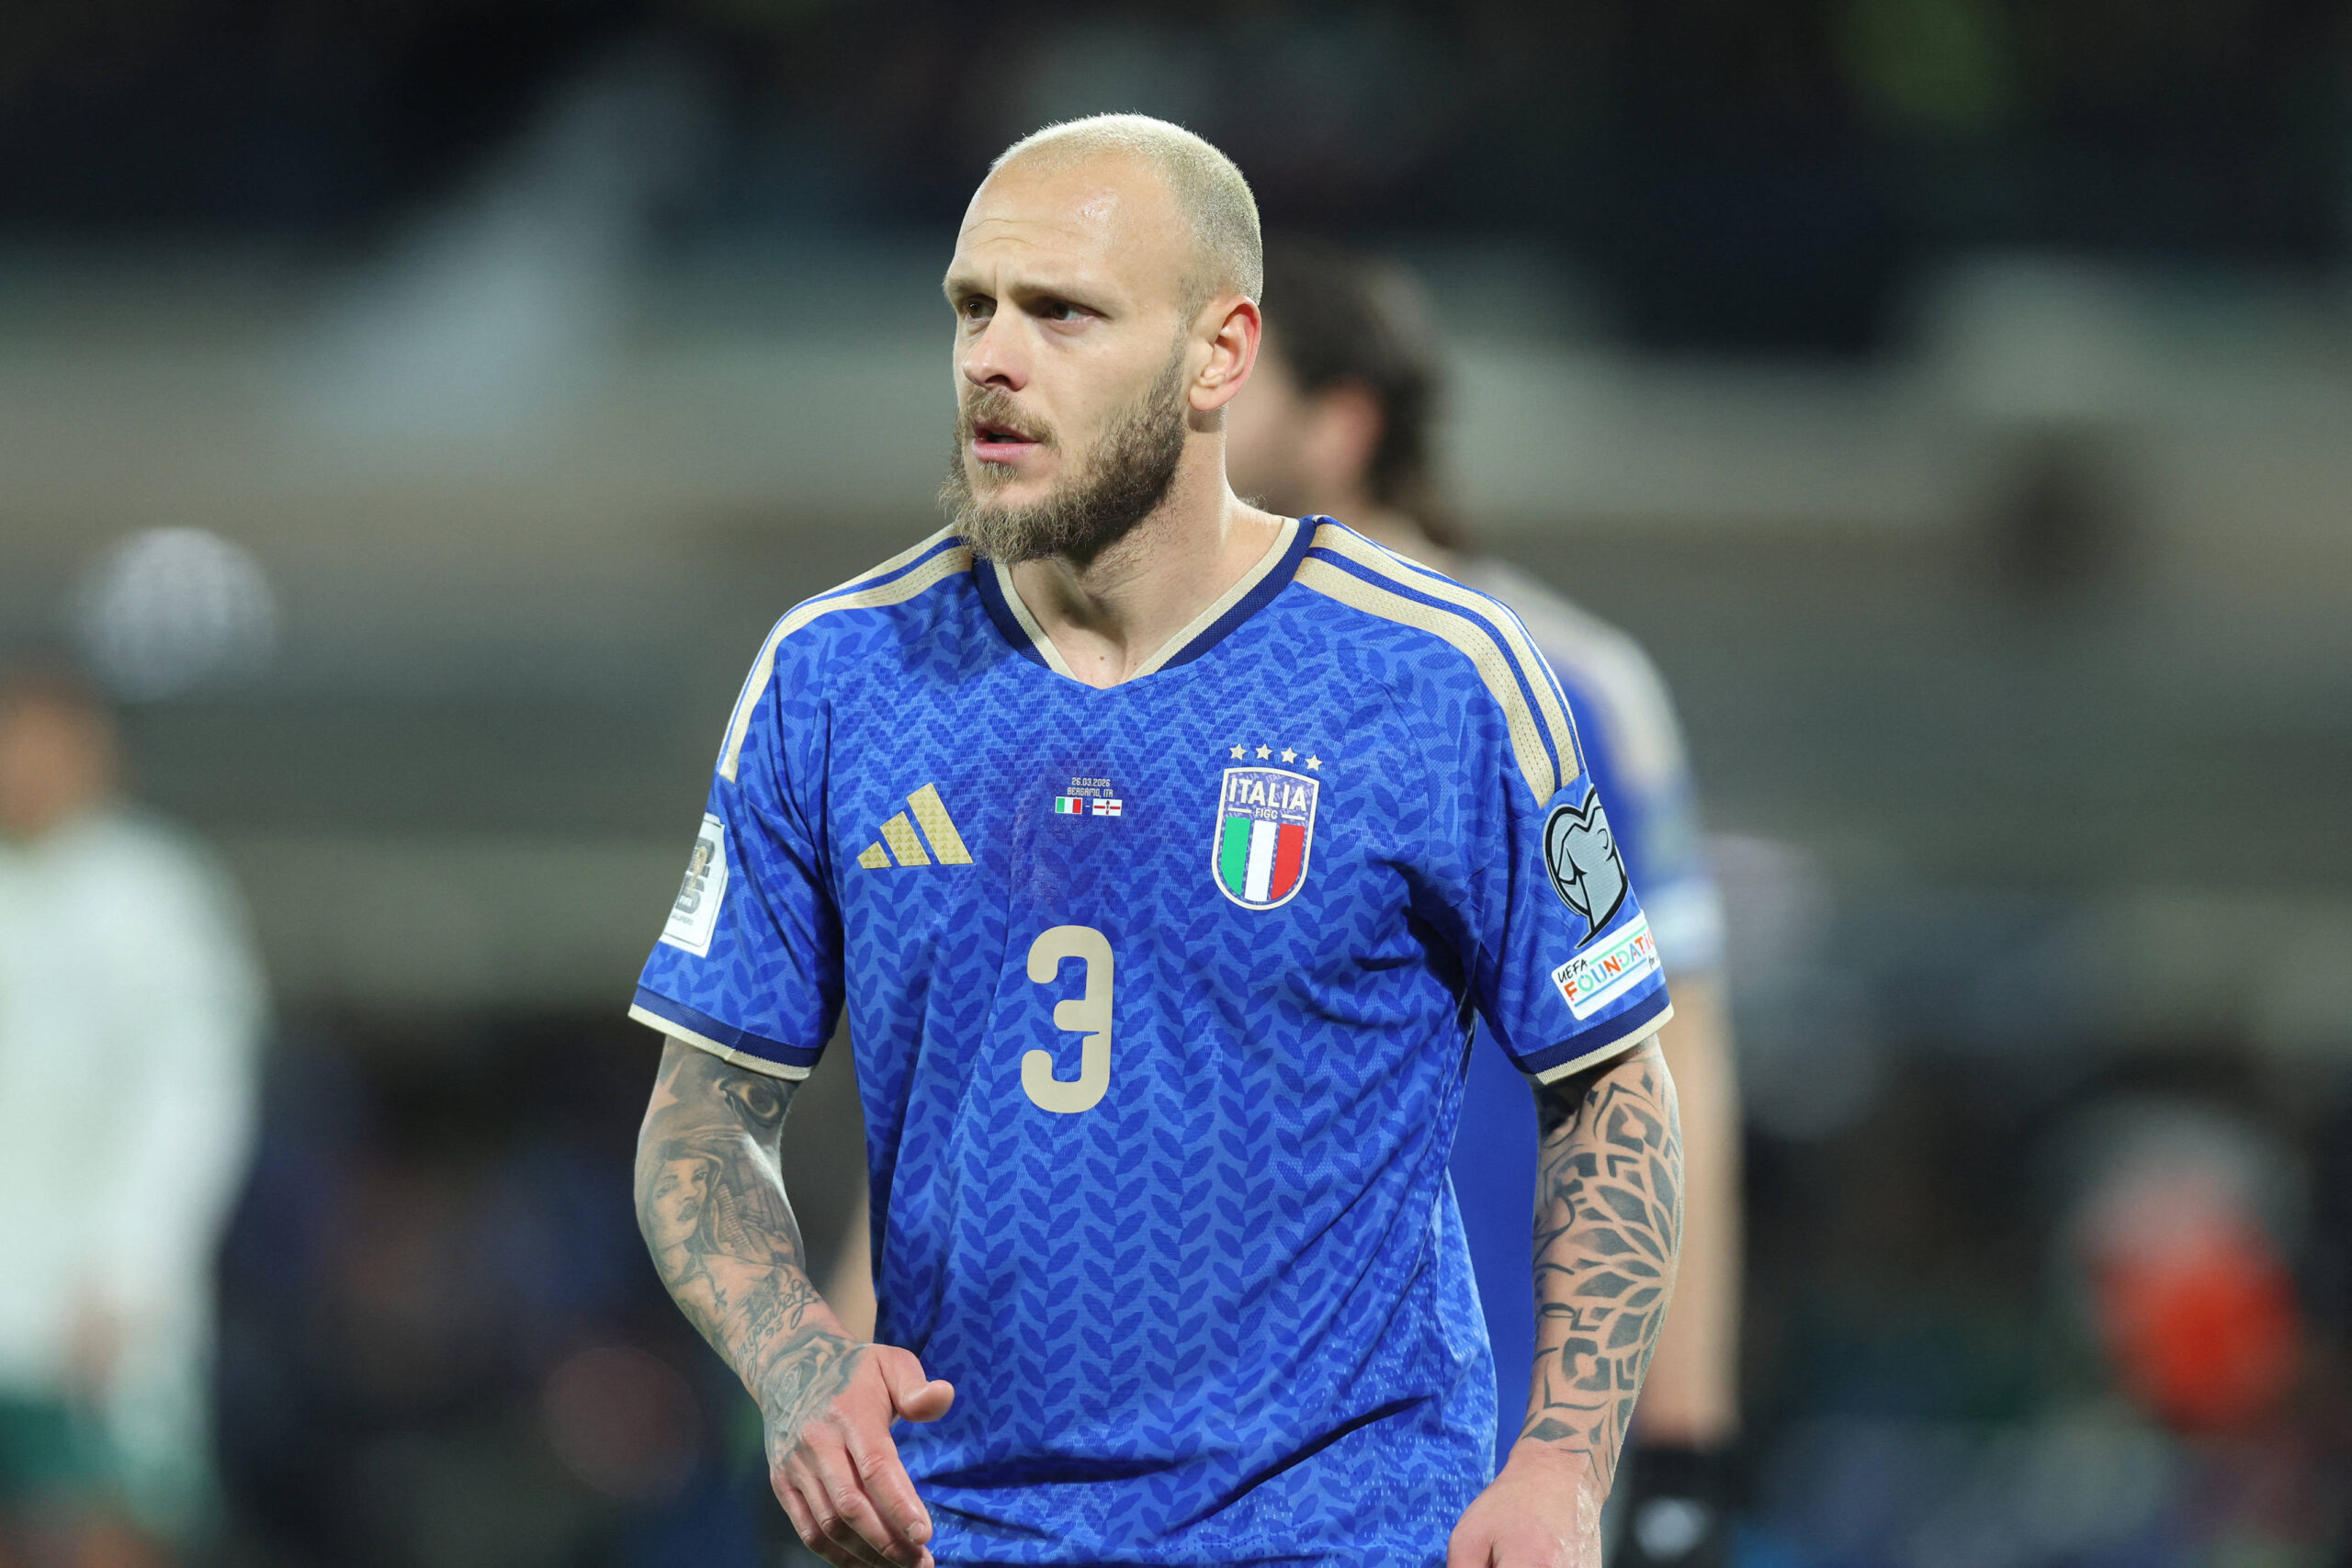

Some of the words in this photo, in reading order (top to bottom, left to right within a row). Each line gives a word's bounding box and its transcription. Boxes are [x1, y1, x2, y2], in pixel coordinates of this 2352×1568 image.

[1071, 777, 1110, 787] 26.03.2026
[1067, 787, 1102, 797] BERGAMO,
[1103, 788, 1114, 797] ITA
[1228, 777, 1306, 812] ITALIA
[1255, 807, 1279, 820] FIGC
[1557, 958, 1588, 984] UEFA
[1021, 925, 1114, 1114] 3
